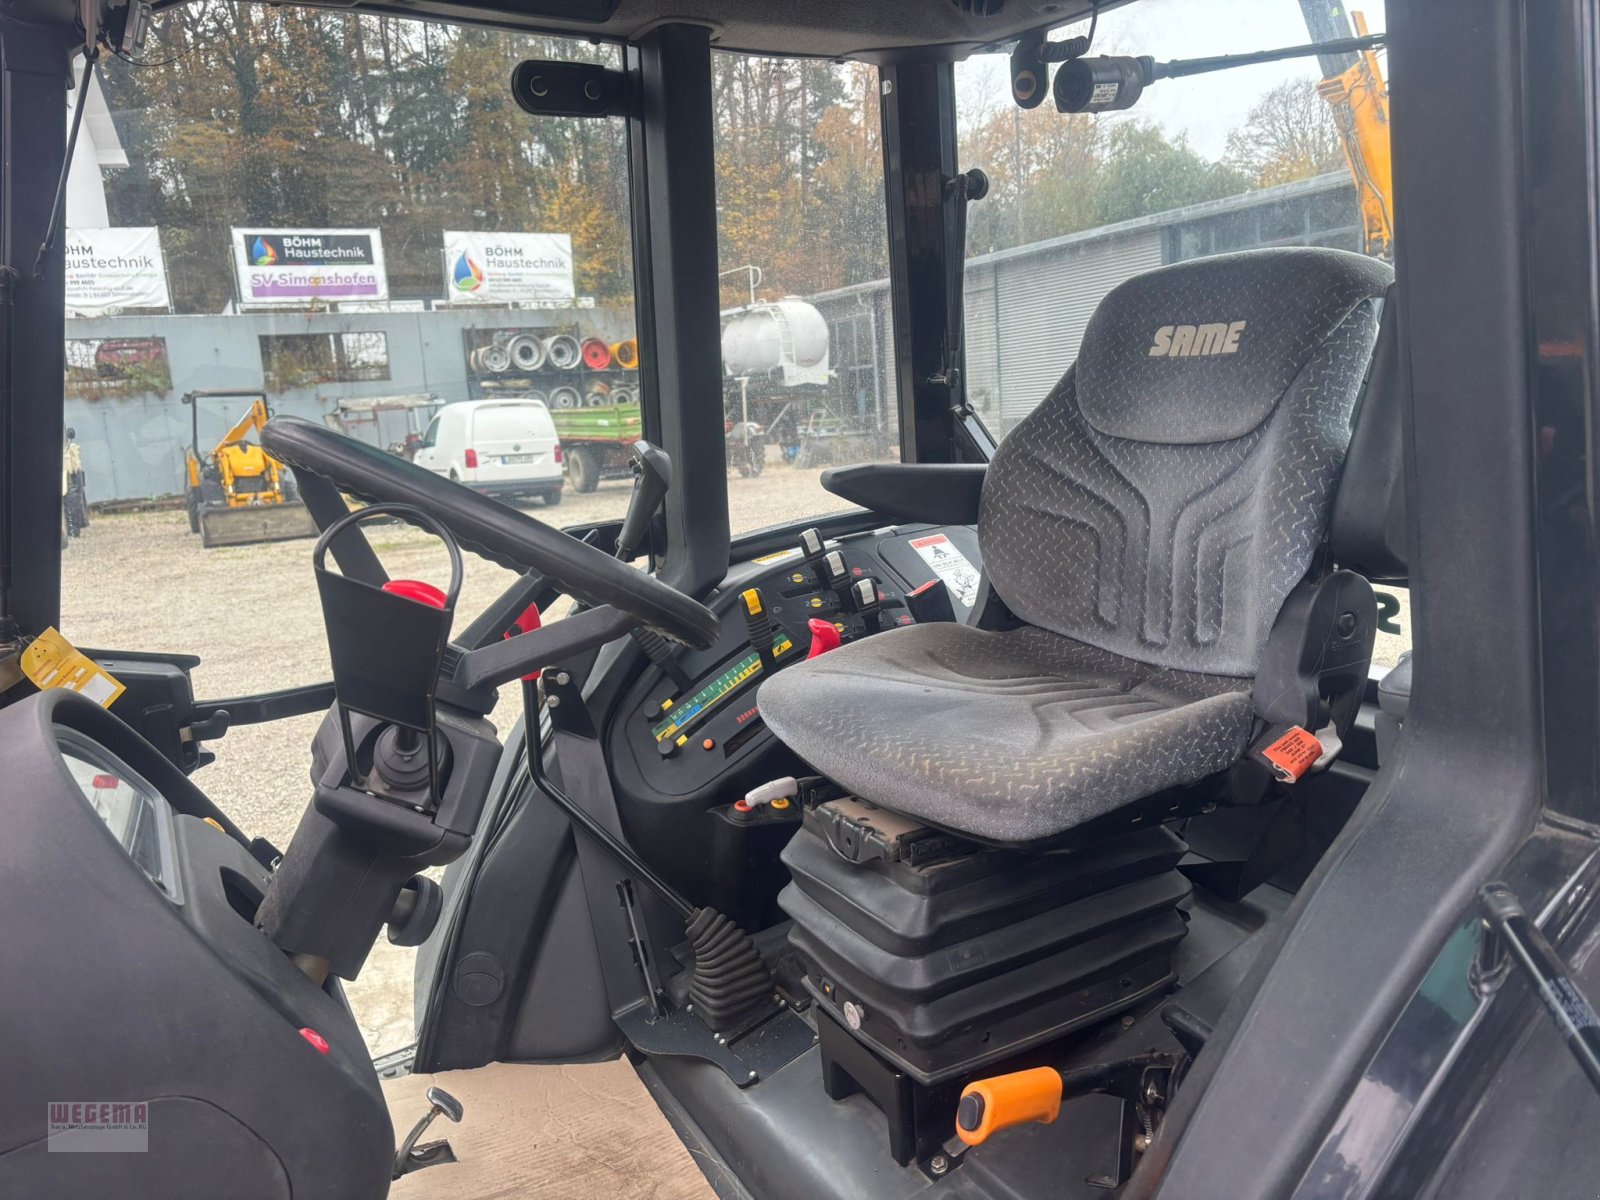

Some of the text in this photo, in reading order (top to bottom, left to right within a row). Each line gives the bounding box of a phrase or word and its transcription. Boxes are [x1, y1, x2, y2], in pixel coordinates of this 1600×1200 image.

[282, 236, 322, 247] BÖHM
[285, 247, 366, 258] Haustechnik
[485, 245, 523, 256] BÖHM
[486, 257, 567, 269] Haustechnik
[252, 272, 377, 287] SV Simonshofen
[1148, 320, 1247, 357] SAME
